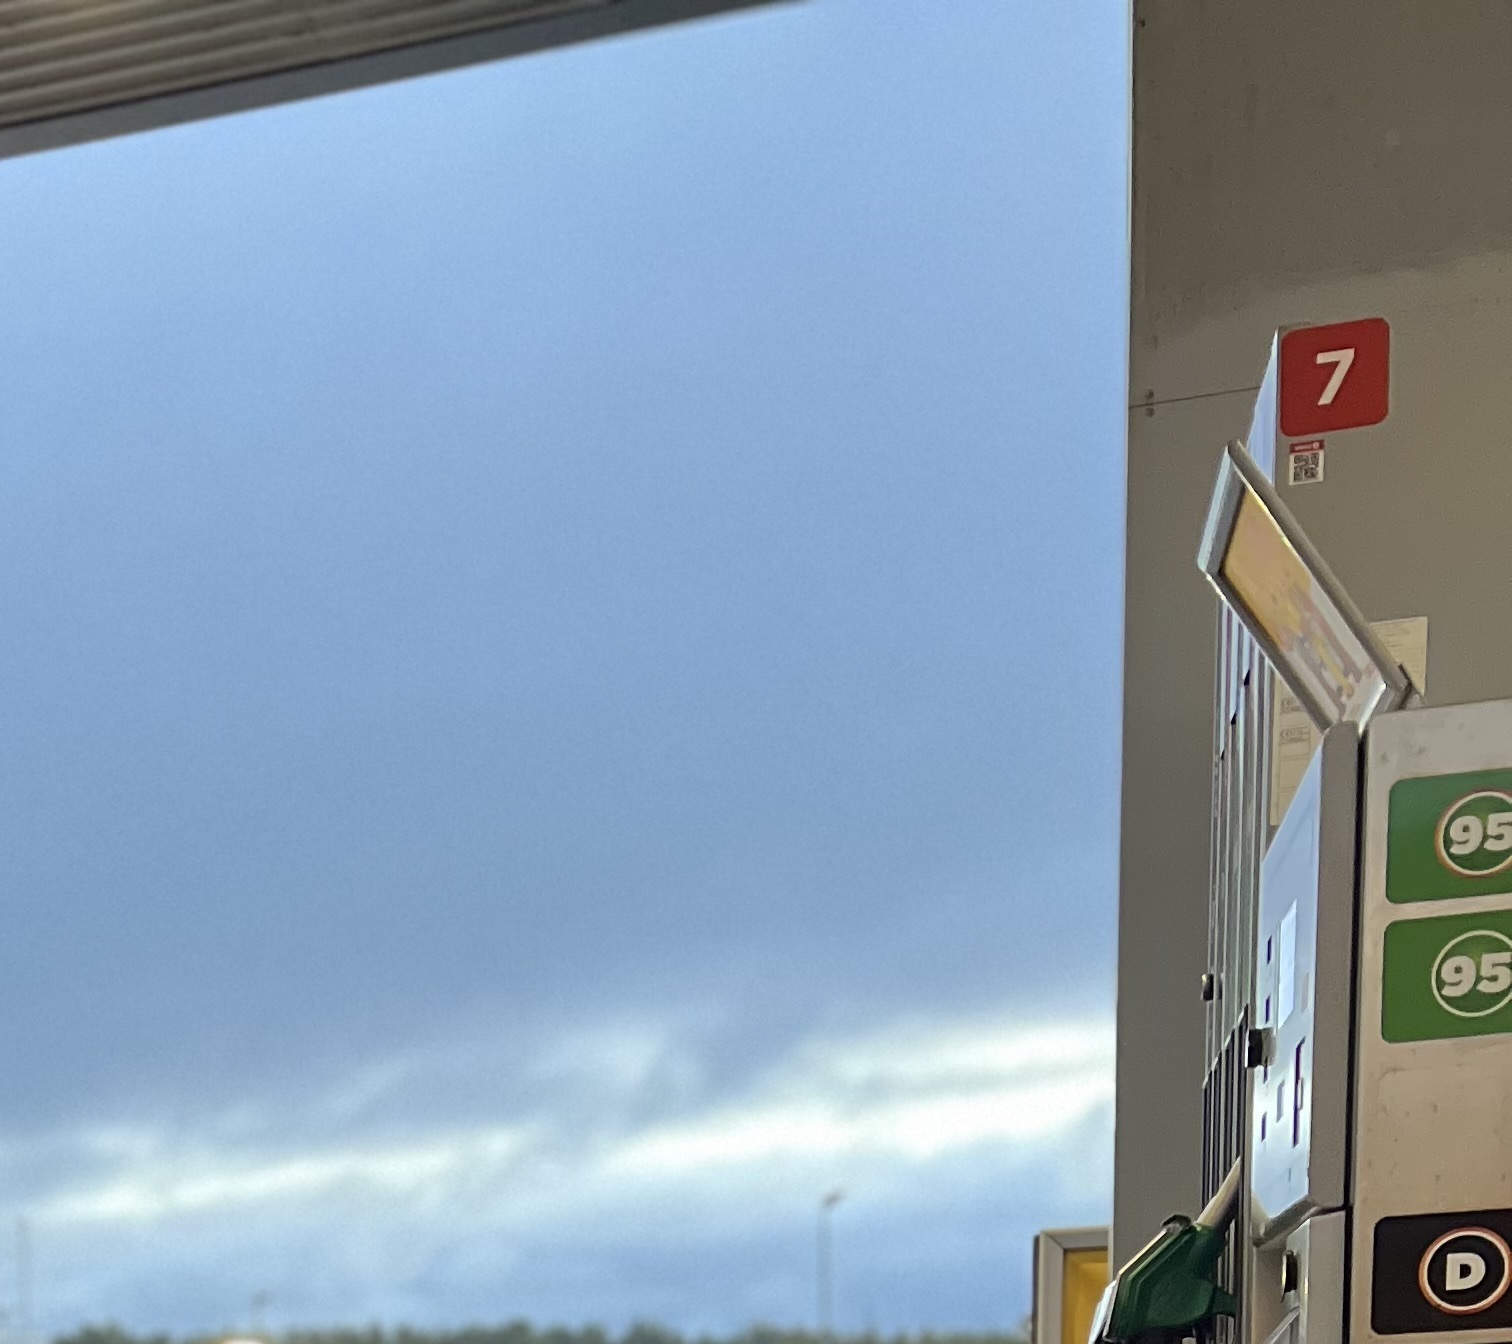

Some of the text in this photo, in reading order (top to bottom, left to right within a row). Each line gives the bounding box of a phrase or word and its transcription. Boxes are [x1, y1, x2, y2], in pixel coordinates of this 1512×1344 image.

[1315, 347, 1355, 406] 7
[1449, 811, 1512, 855] 95
[1440, 951, 1512, 997] 95
[1445, 1252, 1486, 1291] D
